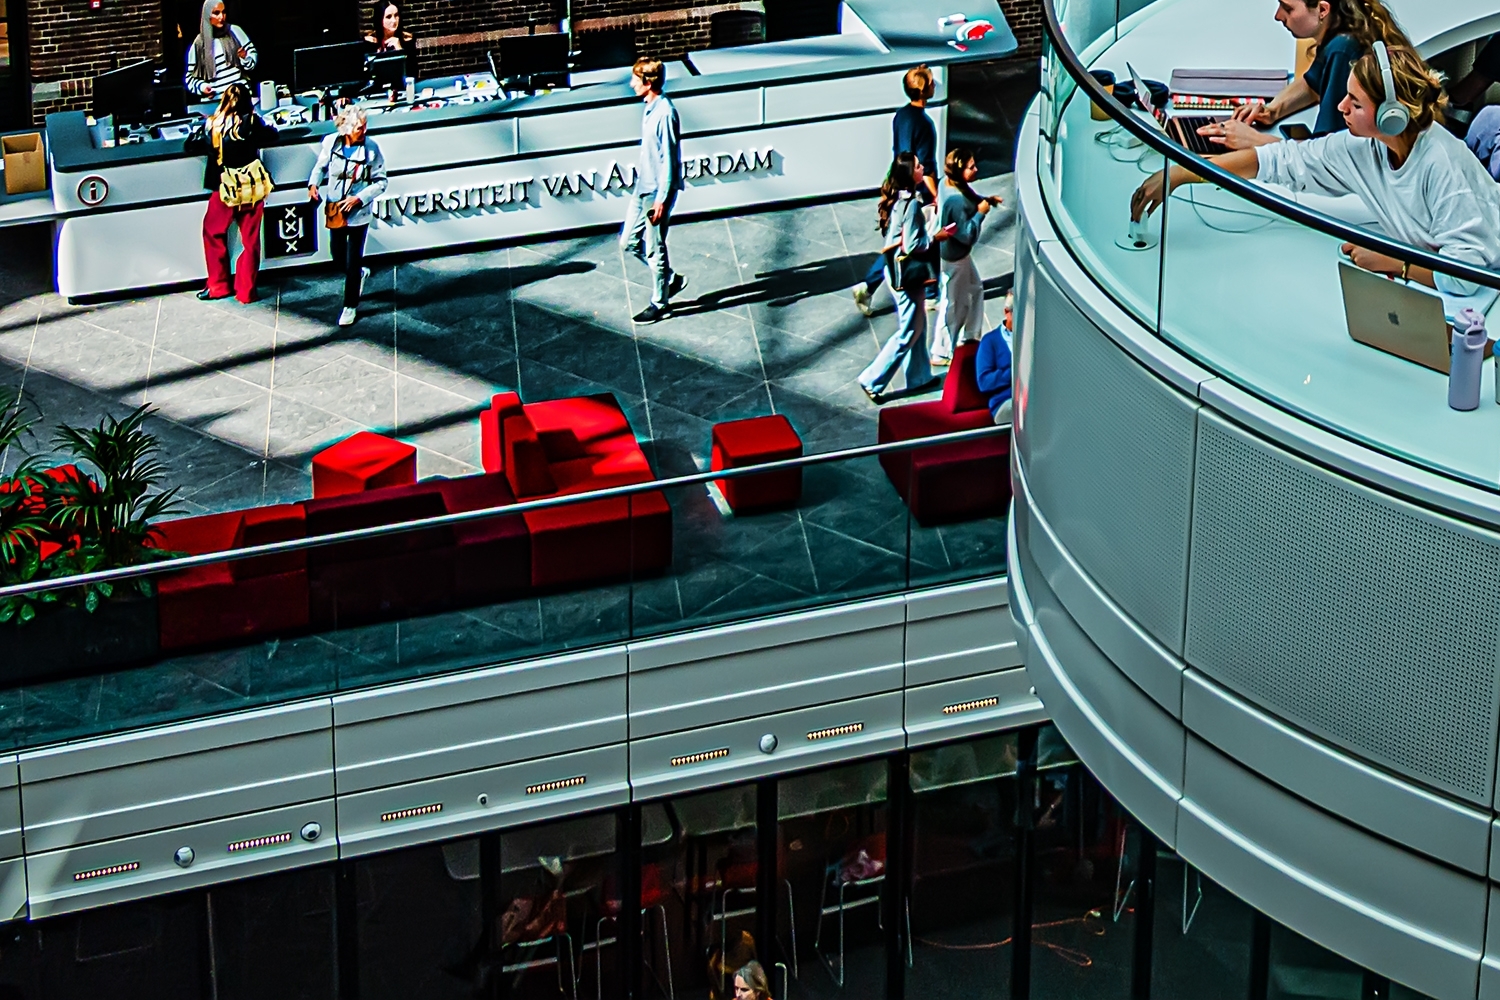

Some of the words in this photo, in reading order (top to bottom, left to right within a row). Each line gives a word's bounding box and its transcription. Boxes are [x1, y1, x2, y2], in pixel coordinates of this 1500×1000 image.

[373, 176, 535, 220] IVERSITEIT
[541, 169, 598, 197] VAN
[603, 147, 774, 192] AERDAM
